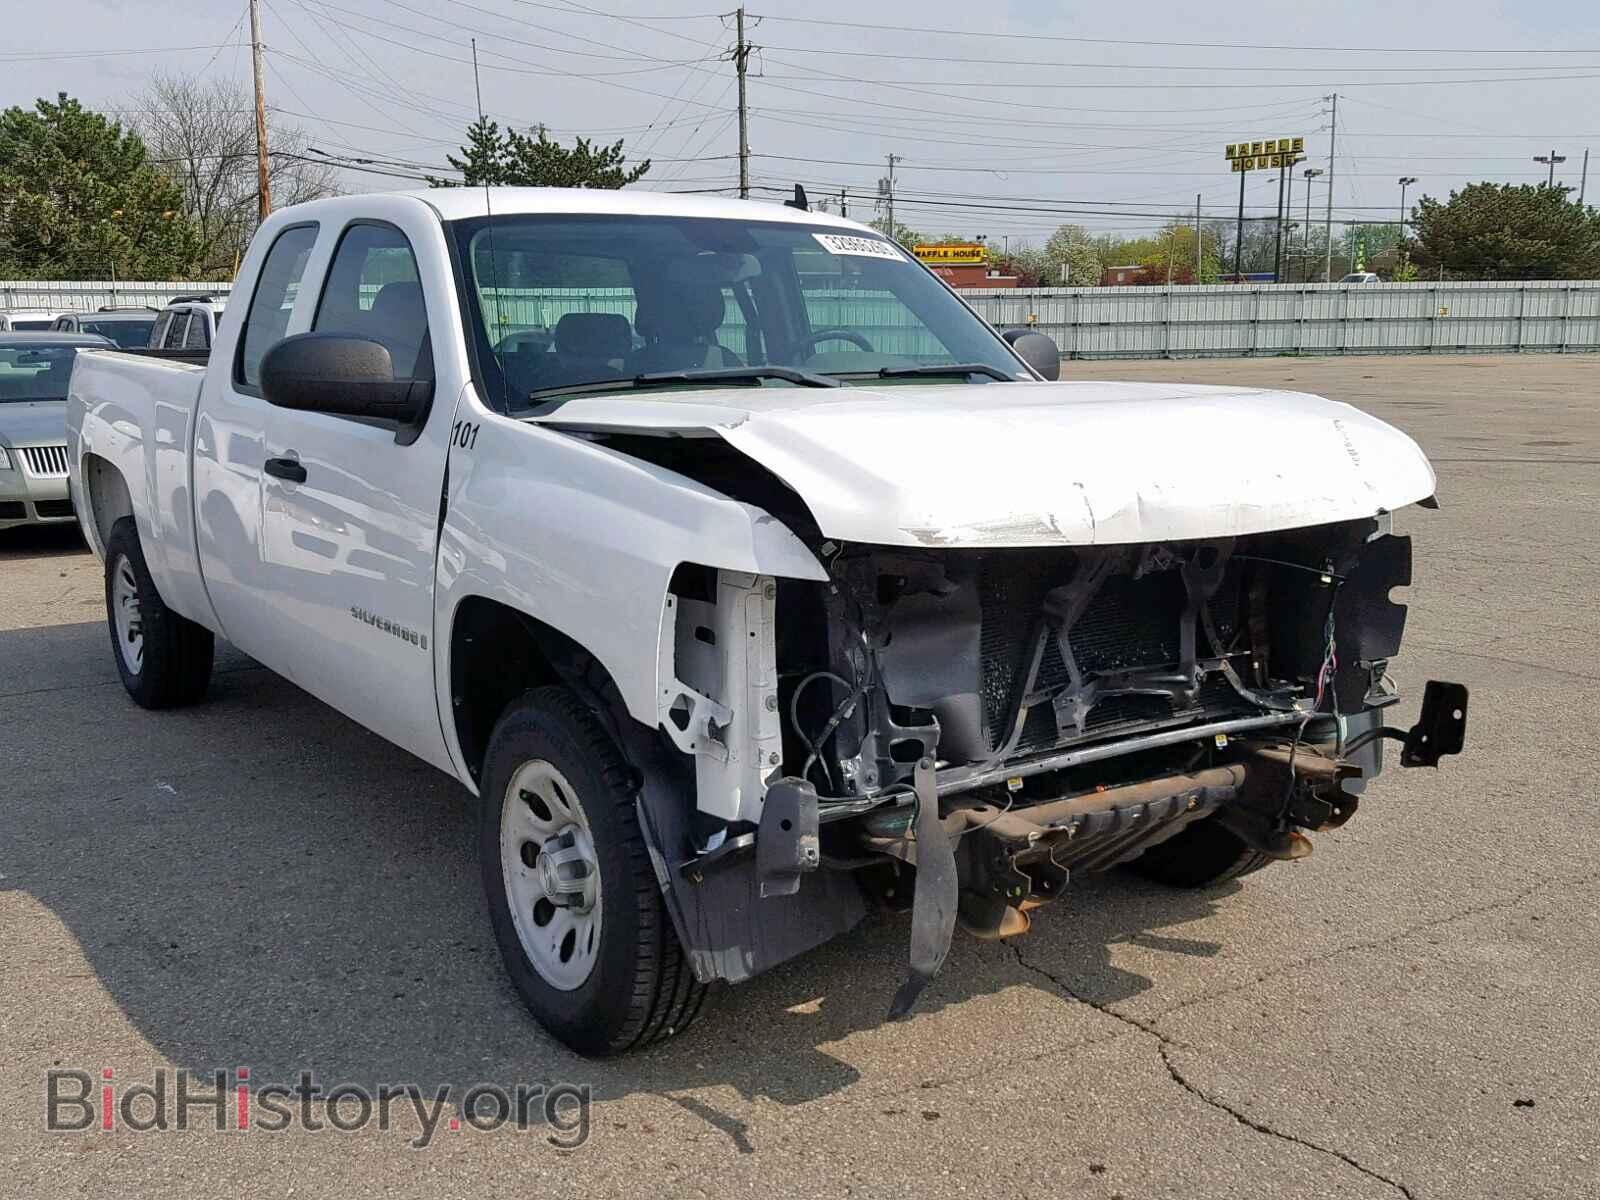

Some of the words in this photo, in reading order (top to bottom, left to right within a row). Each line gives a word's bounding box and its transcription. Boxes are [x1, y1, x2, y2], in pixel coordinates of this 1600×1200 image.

[1226, 139, 1303, 157] WAFFLE
[453, 420, 480, 449] 101
[351, 607, 418, 645] SILVERADO
